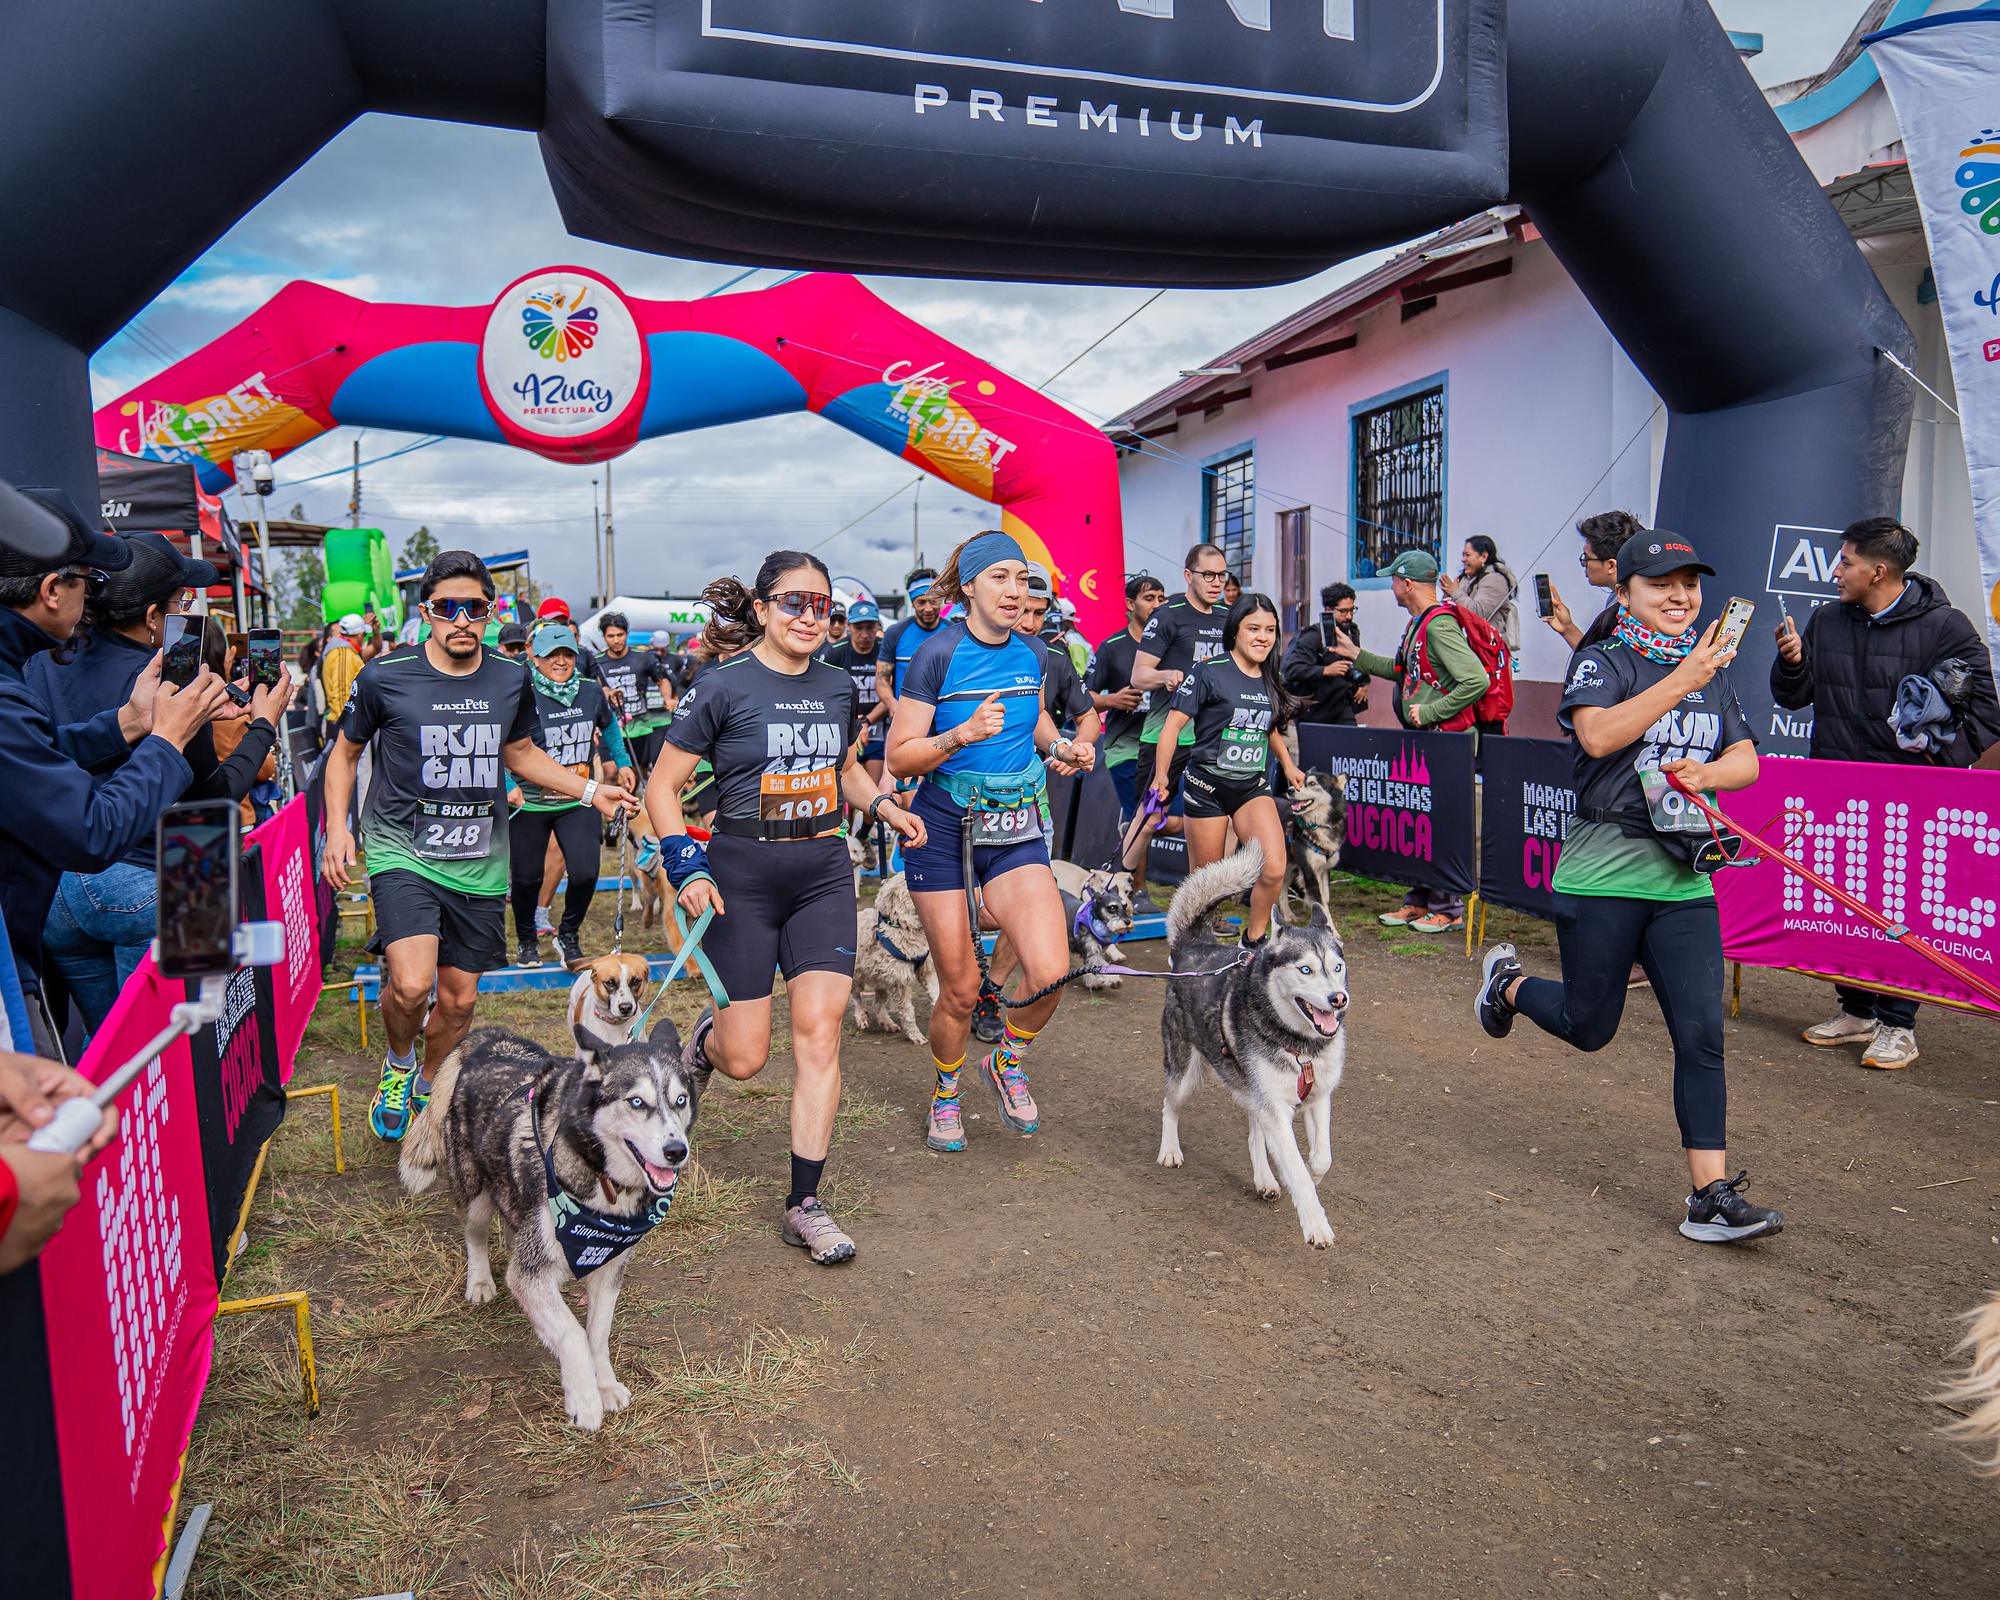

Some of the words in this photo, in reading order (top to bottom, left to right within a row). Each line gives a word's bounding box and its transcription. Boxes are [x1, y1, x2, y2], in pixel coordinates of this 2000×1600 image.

[914, 84, 1264, 148] PREMIUM
[150, 371, 277, 463] LLORET
[523, 406, 594, 414] PREFECTURA
[890, 384, 1018, 466] LLORET
[101, 500, 132, 517] ÓN
[670, 612, 705, 624] MA
[420, 724, 502, 756] RUN
[544, 720, 594, 748] RUN
[767, 723, 841, 757] RUN
[1643, 710, 1720, 750] RUN
[1226, 745, 1263, 763] 060
[1332, 753, 1389, 780] MARATÓN
[421, 755, 499, 789] CAN
[790, 774, 821, 791] 6KM
[441, 804, 474, 817] 8KM
[1343, 778, 1359, 801] AS
[1362, 778, 1432, 812] IGLESIAS
[1523, 781, 1577, 812] MARAT
[426, 824, 480, 847] 248
[982, 811, 1029, 832] 269
[1343, 802, 1432, 862] UENCA
[1524, 806, 1557, 838] LAS
[1151, 839, 1184, 852] EMIUM
[1784, 919, 1843, 935] MARATÓN
[1846, 924, 1869, 938] LAS
[1932, 938, 1994, 965] CUENCA
